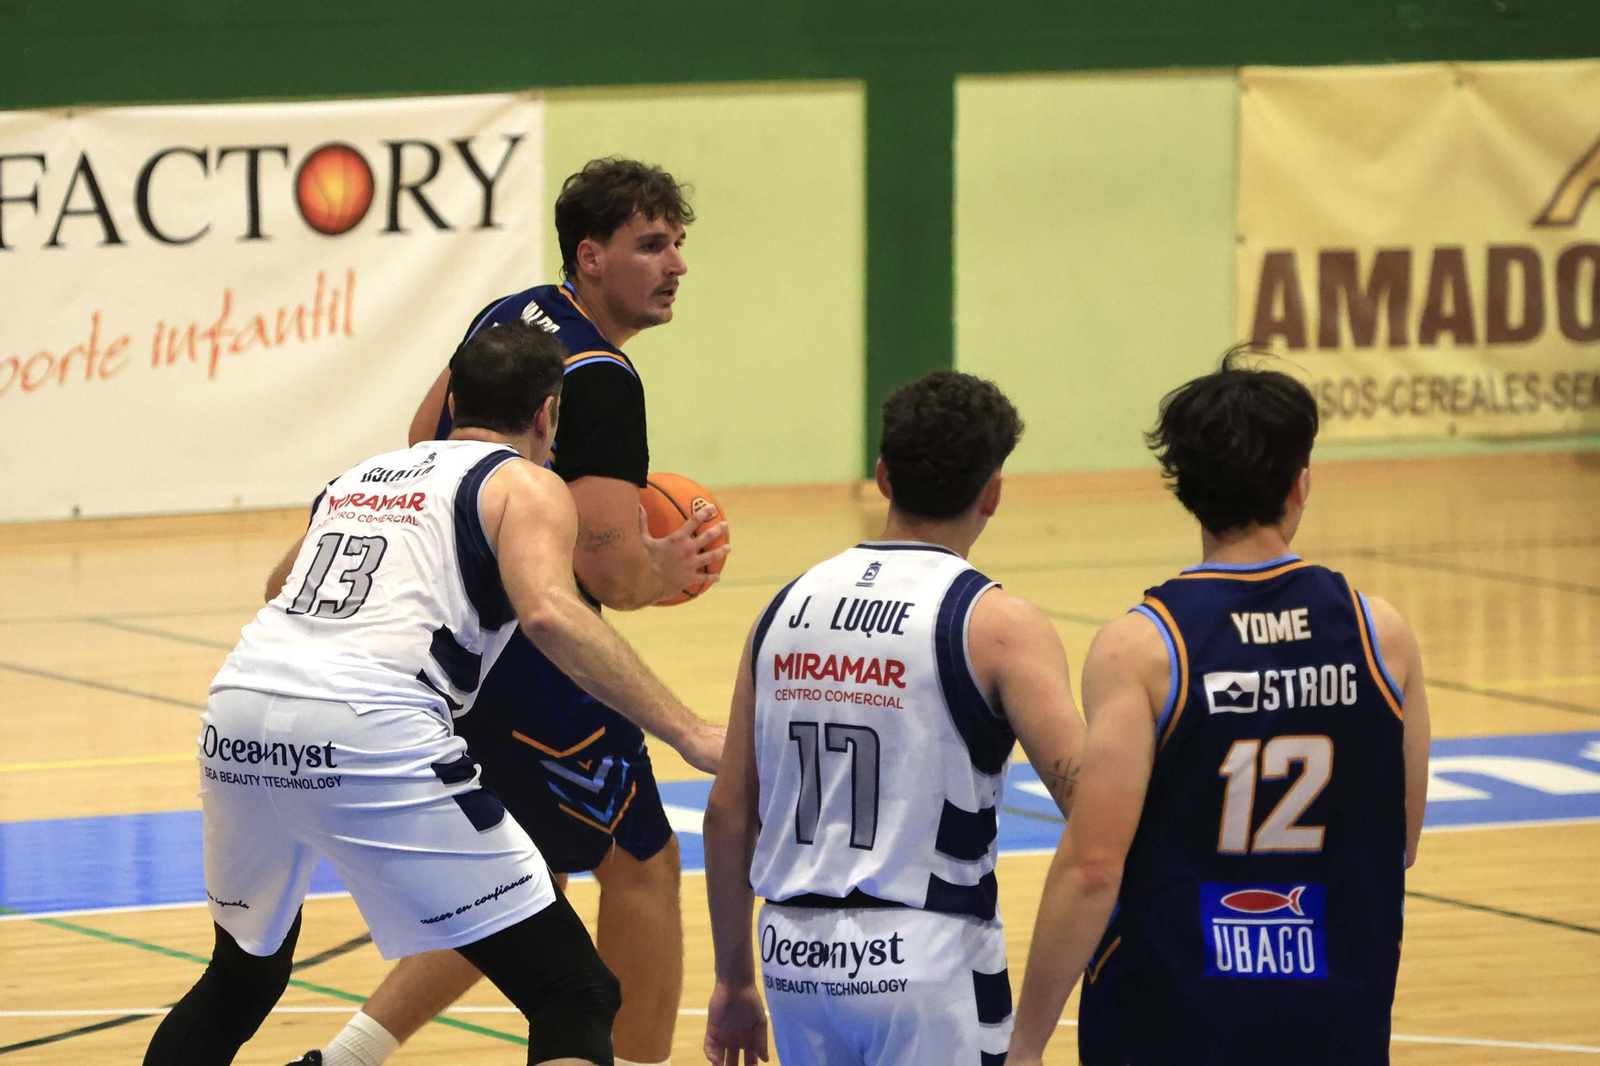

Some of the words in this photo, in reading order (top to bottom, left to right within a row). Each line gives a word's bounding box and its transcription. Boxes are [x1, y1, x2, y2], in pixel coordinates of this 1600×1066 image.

[0, 133, 527, 251] FACTORY
[1250, 242, 1600, 351] AMADO
[151, 266, 357, 380] infantil
[327, 492, 426, 515] MIRAMAR
[286, 532, 388, 619] 13
[788, 595, 812, 629] J.
[830, 597, 915, 639] LUQUE
[1230, 607, 1312, 644] YOME
[774, 653, 906, 689] MIRAMAR
[1263, 663, 1358, 711] STROG
[775, 688, 821, 701] CENTRO
[825, 690, 904, 710] COMERCIAL
[203, 725, 338, 776] Oceanyst
[205, 766, 218, 781] SEA
[219, 771, 260, 787] BEAUTY
[789, 721, 880, 851] 17
[1217, 735, 1335, 855] 12
[761, 924, 905, 979] Oceanyst
[1212, 925, 1315, 974] UBAGO
[776, 978, 818, 994] BEAUTY
[821, 978, 908, 996] TECHNOLOGY
